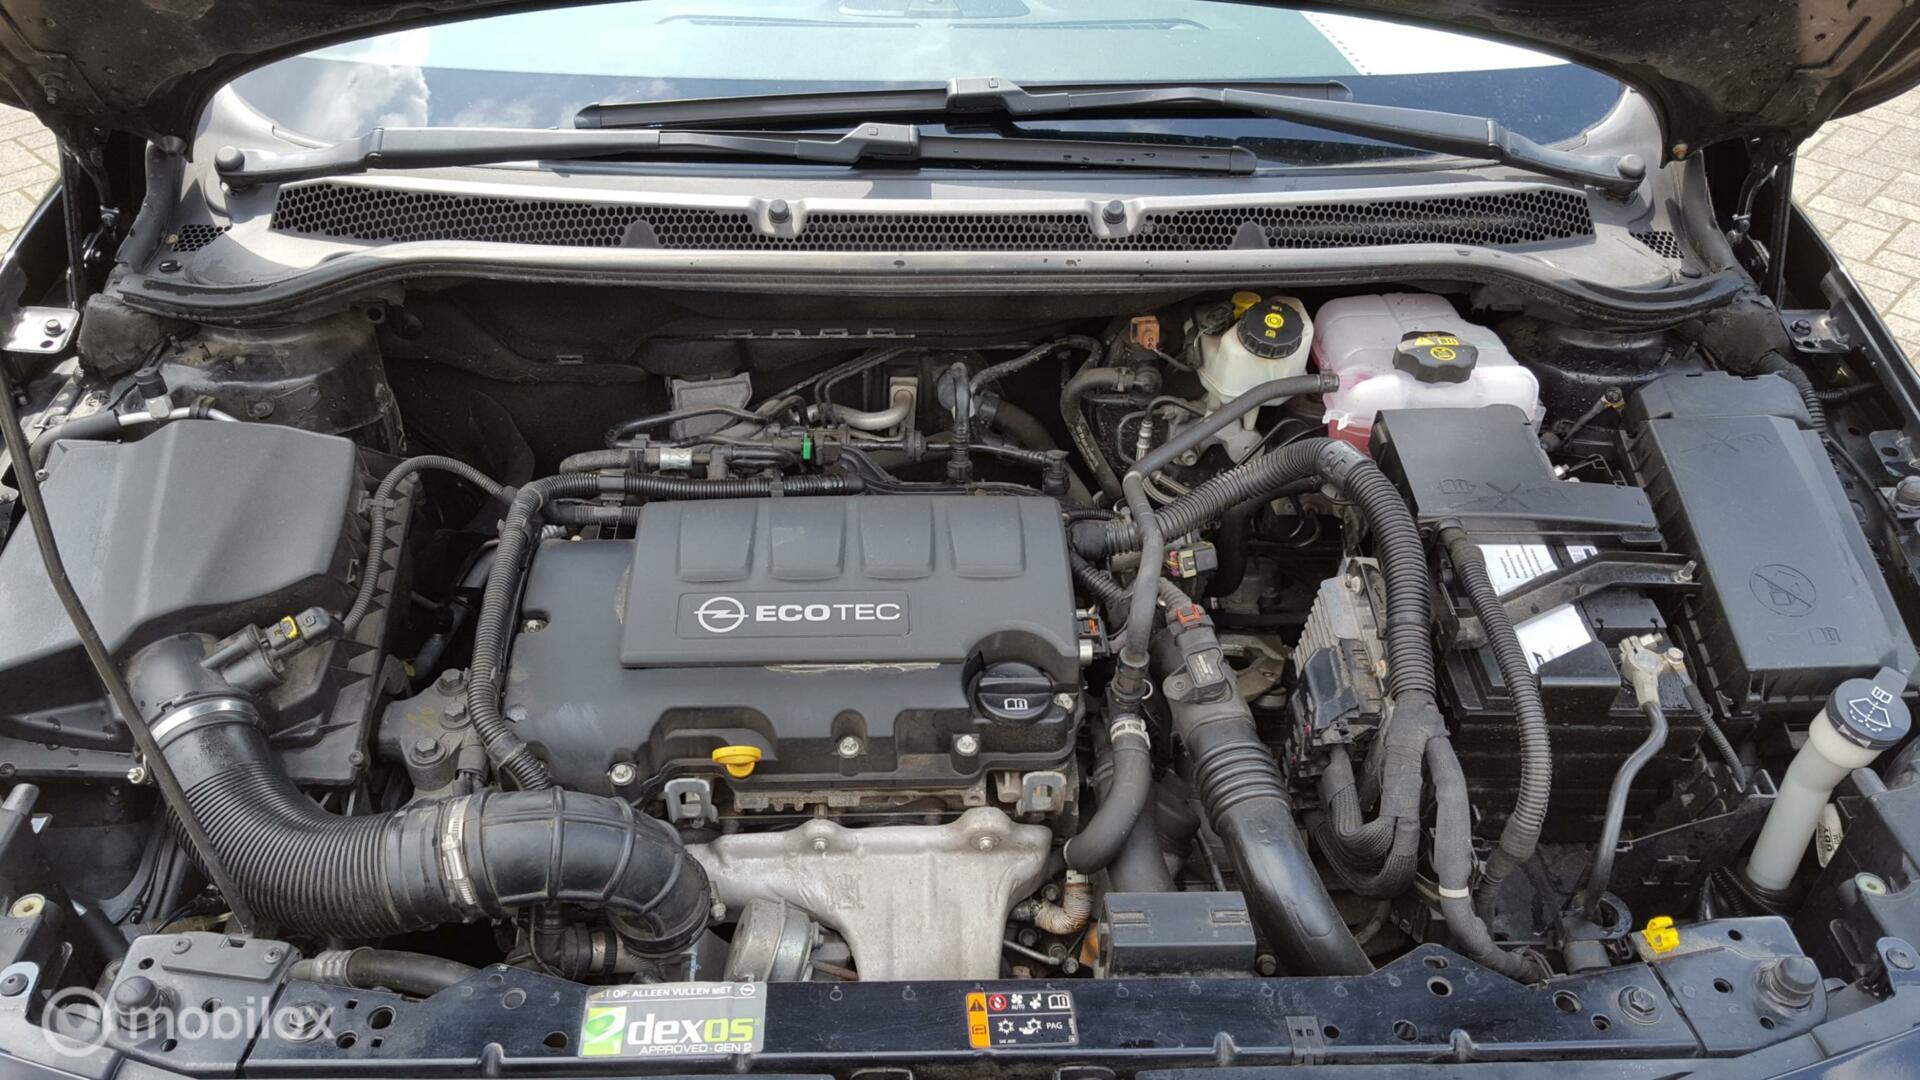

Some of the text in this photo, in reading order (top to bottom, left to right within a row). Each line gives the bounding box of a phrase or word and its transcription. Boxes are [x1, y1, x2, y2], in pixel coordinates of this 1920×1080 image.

[755, 603, 901, 622] ECOTEC
[632, 987, 670, 998] ALLEEN
[670, 986, 711, 997] VULLEN
[712, 985, 733, 995] MET
[627, 1013, 754, 1044] dexos
[1046, 1021, 1063, 1030] PAG
[743, 1043, 753, 1053] 2
